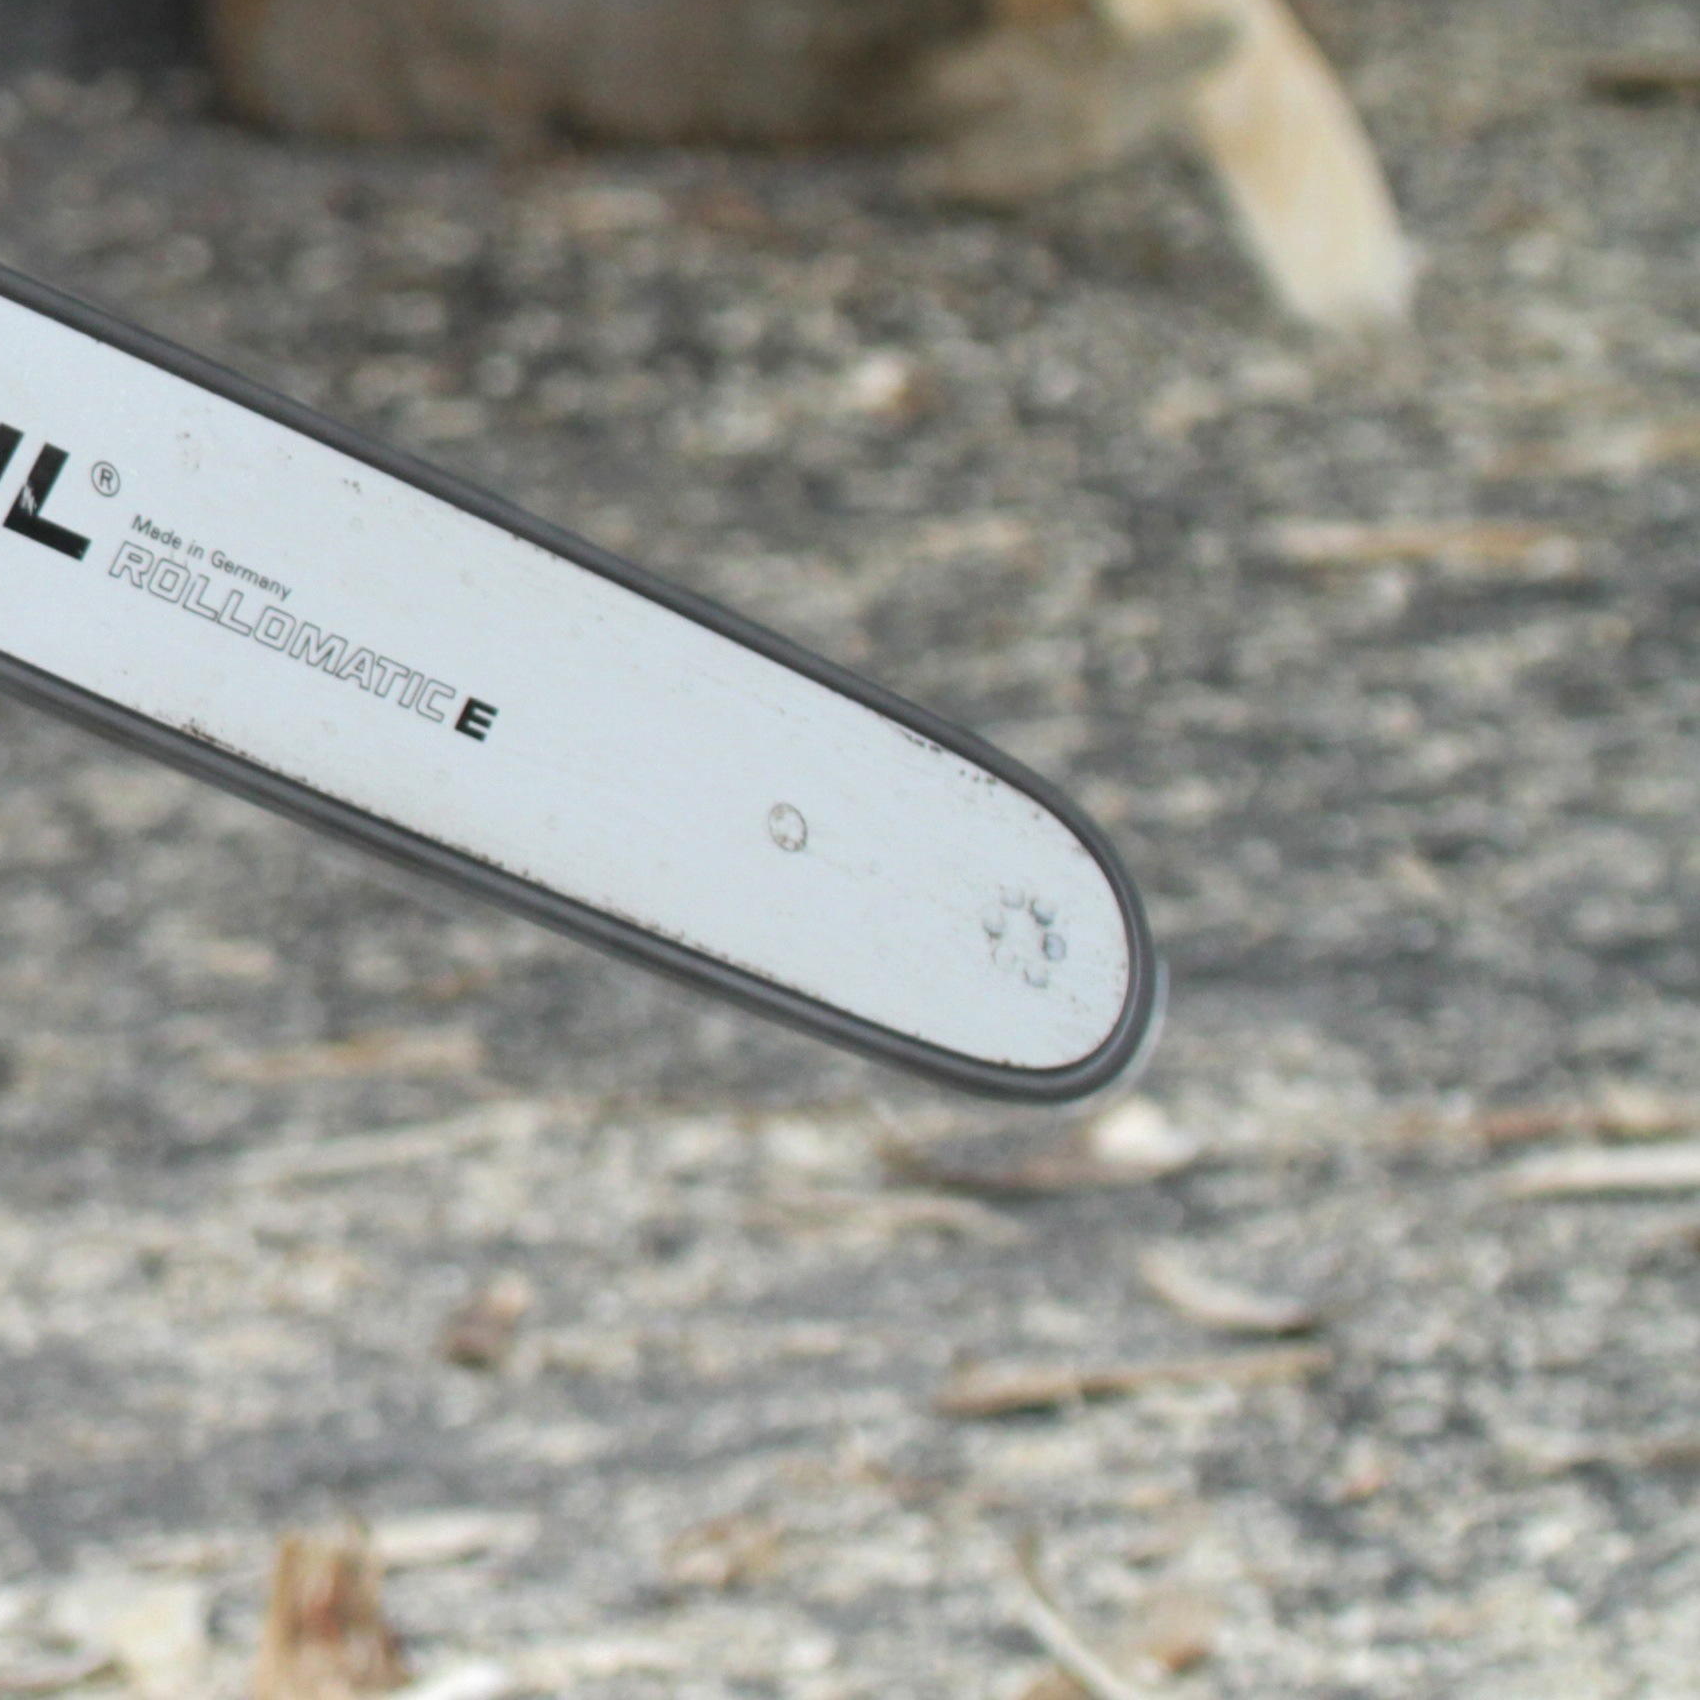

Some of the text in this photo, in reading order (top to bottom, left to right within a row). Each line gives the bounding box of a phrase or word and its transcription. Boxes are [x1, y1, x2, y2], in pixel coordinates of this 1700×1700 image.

[131, 514, 292, 601] Made in Germany
[108, 540, 457, 724] ROLLOMATIC
